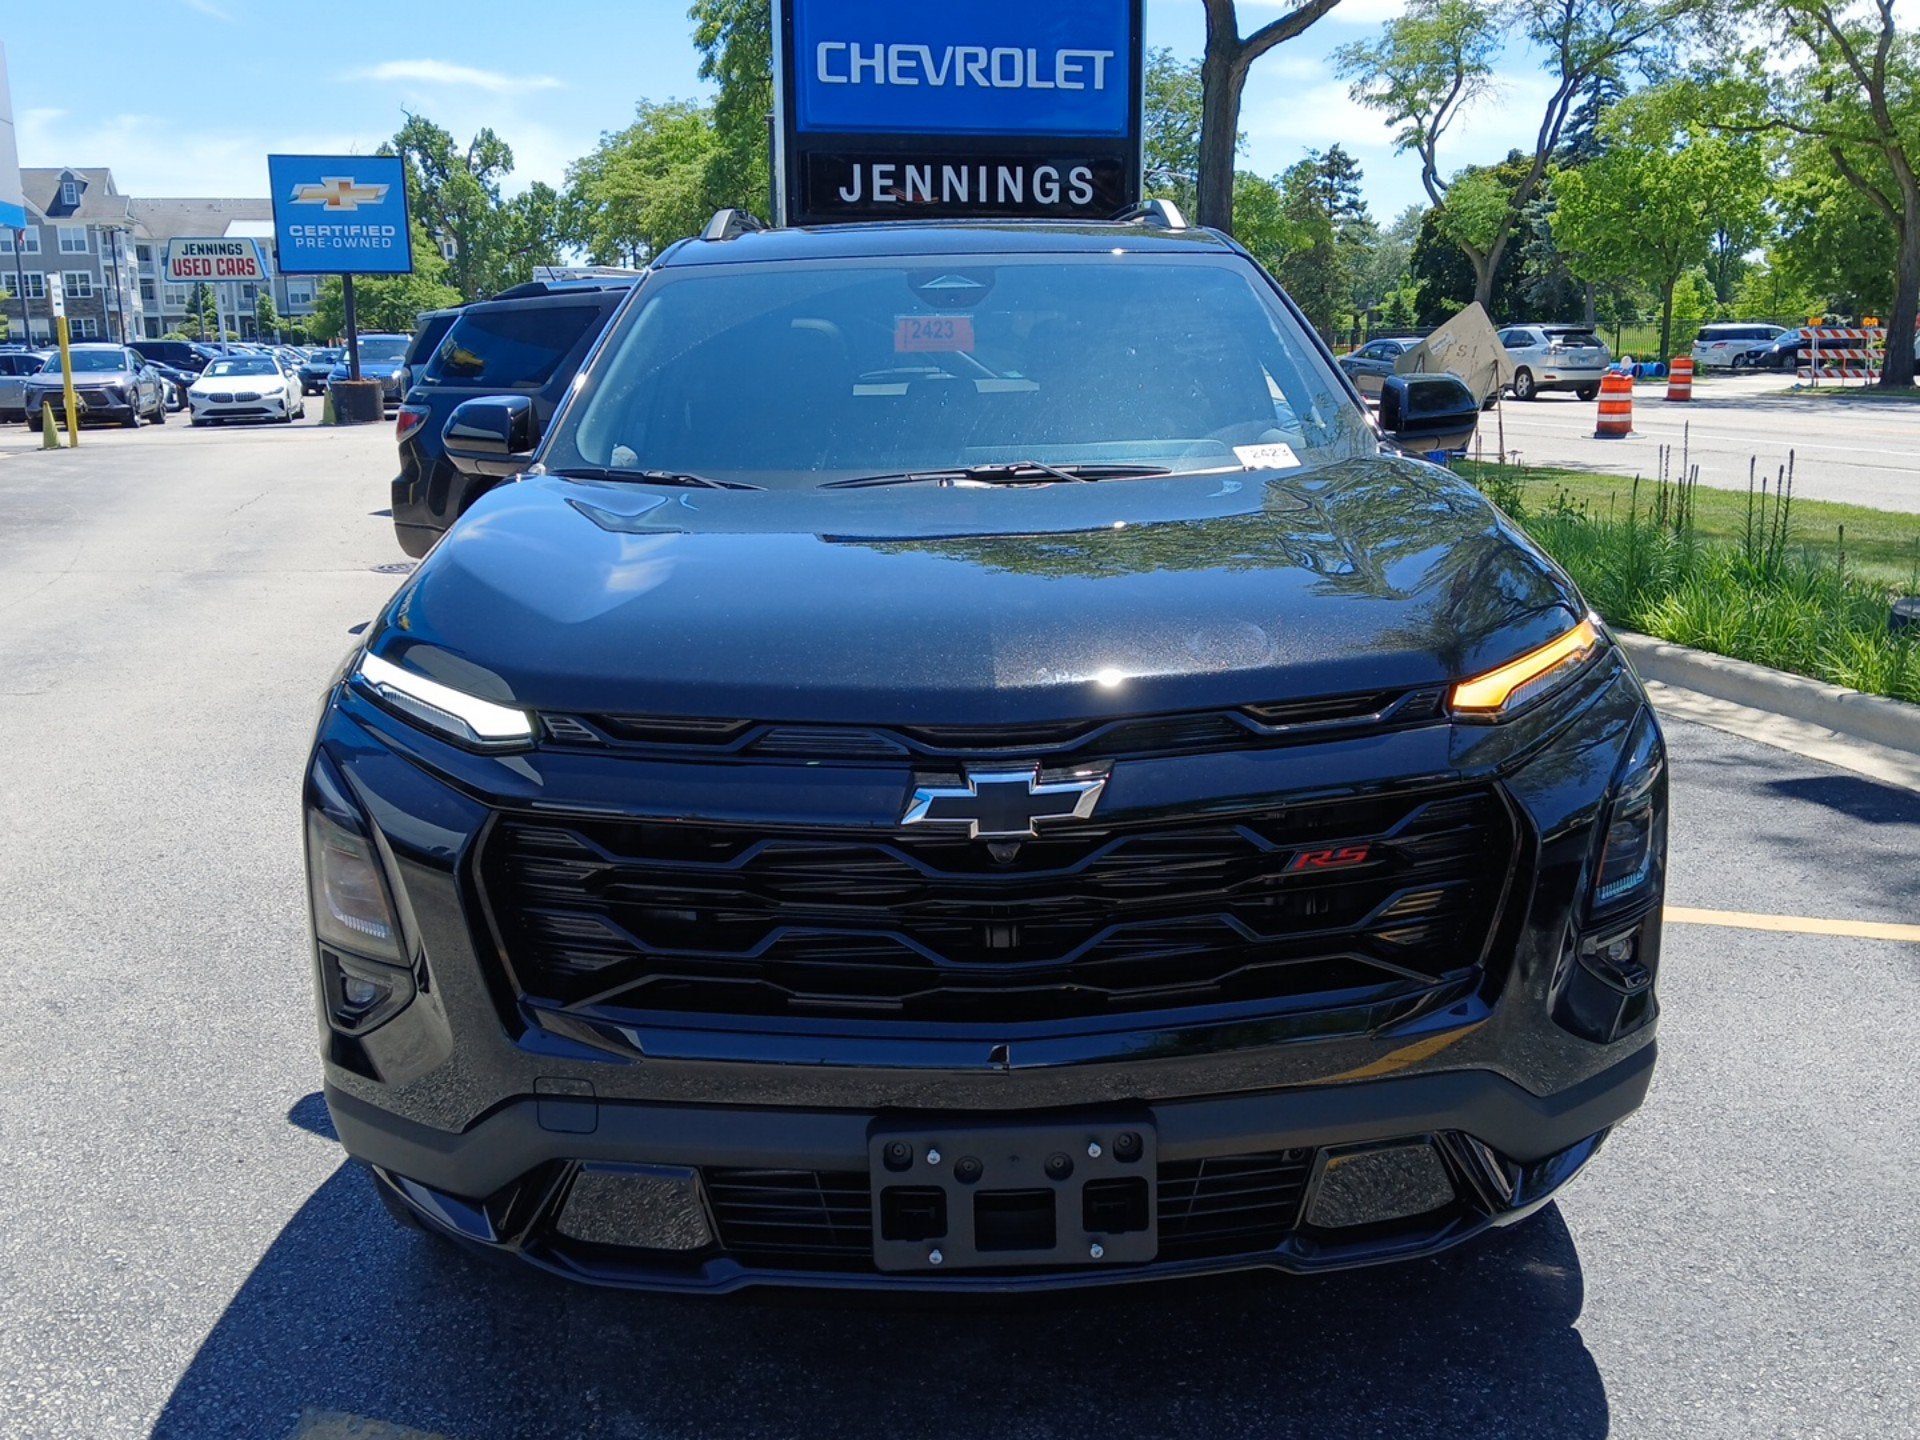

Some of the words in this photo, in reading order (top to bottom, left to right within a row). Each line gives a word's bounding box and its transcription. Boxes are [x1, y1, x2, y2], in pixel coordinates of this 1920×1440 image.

[816, 41, 1115, 90] CHEVROLET
[838, 163, 1094, 206] JENNINGS
[288, 224, 396, 237] CERTIFIED
[181, 243, 244, 256] JENNINGS
[294, 237, 392, 249] PRE-OWNED
[172, 258, 212, 277] USED
[216, 258, 257, 276] CARS
[911, 320, 954, 339] 2423
[1294, 845, 1370, 871] RS
